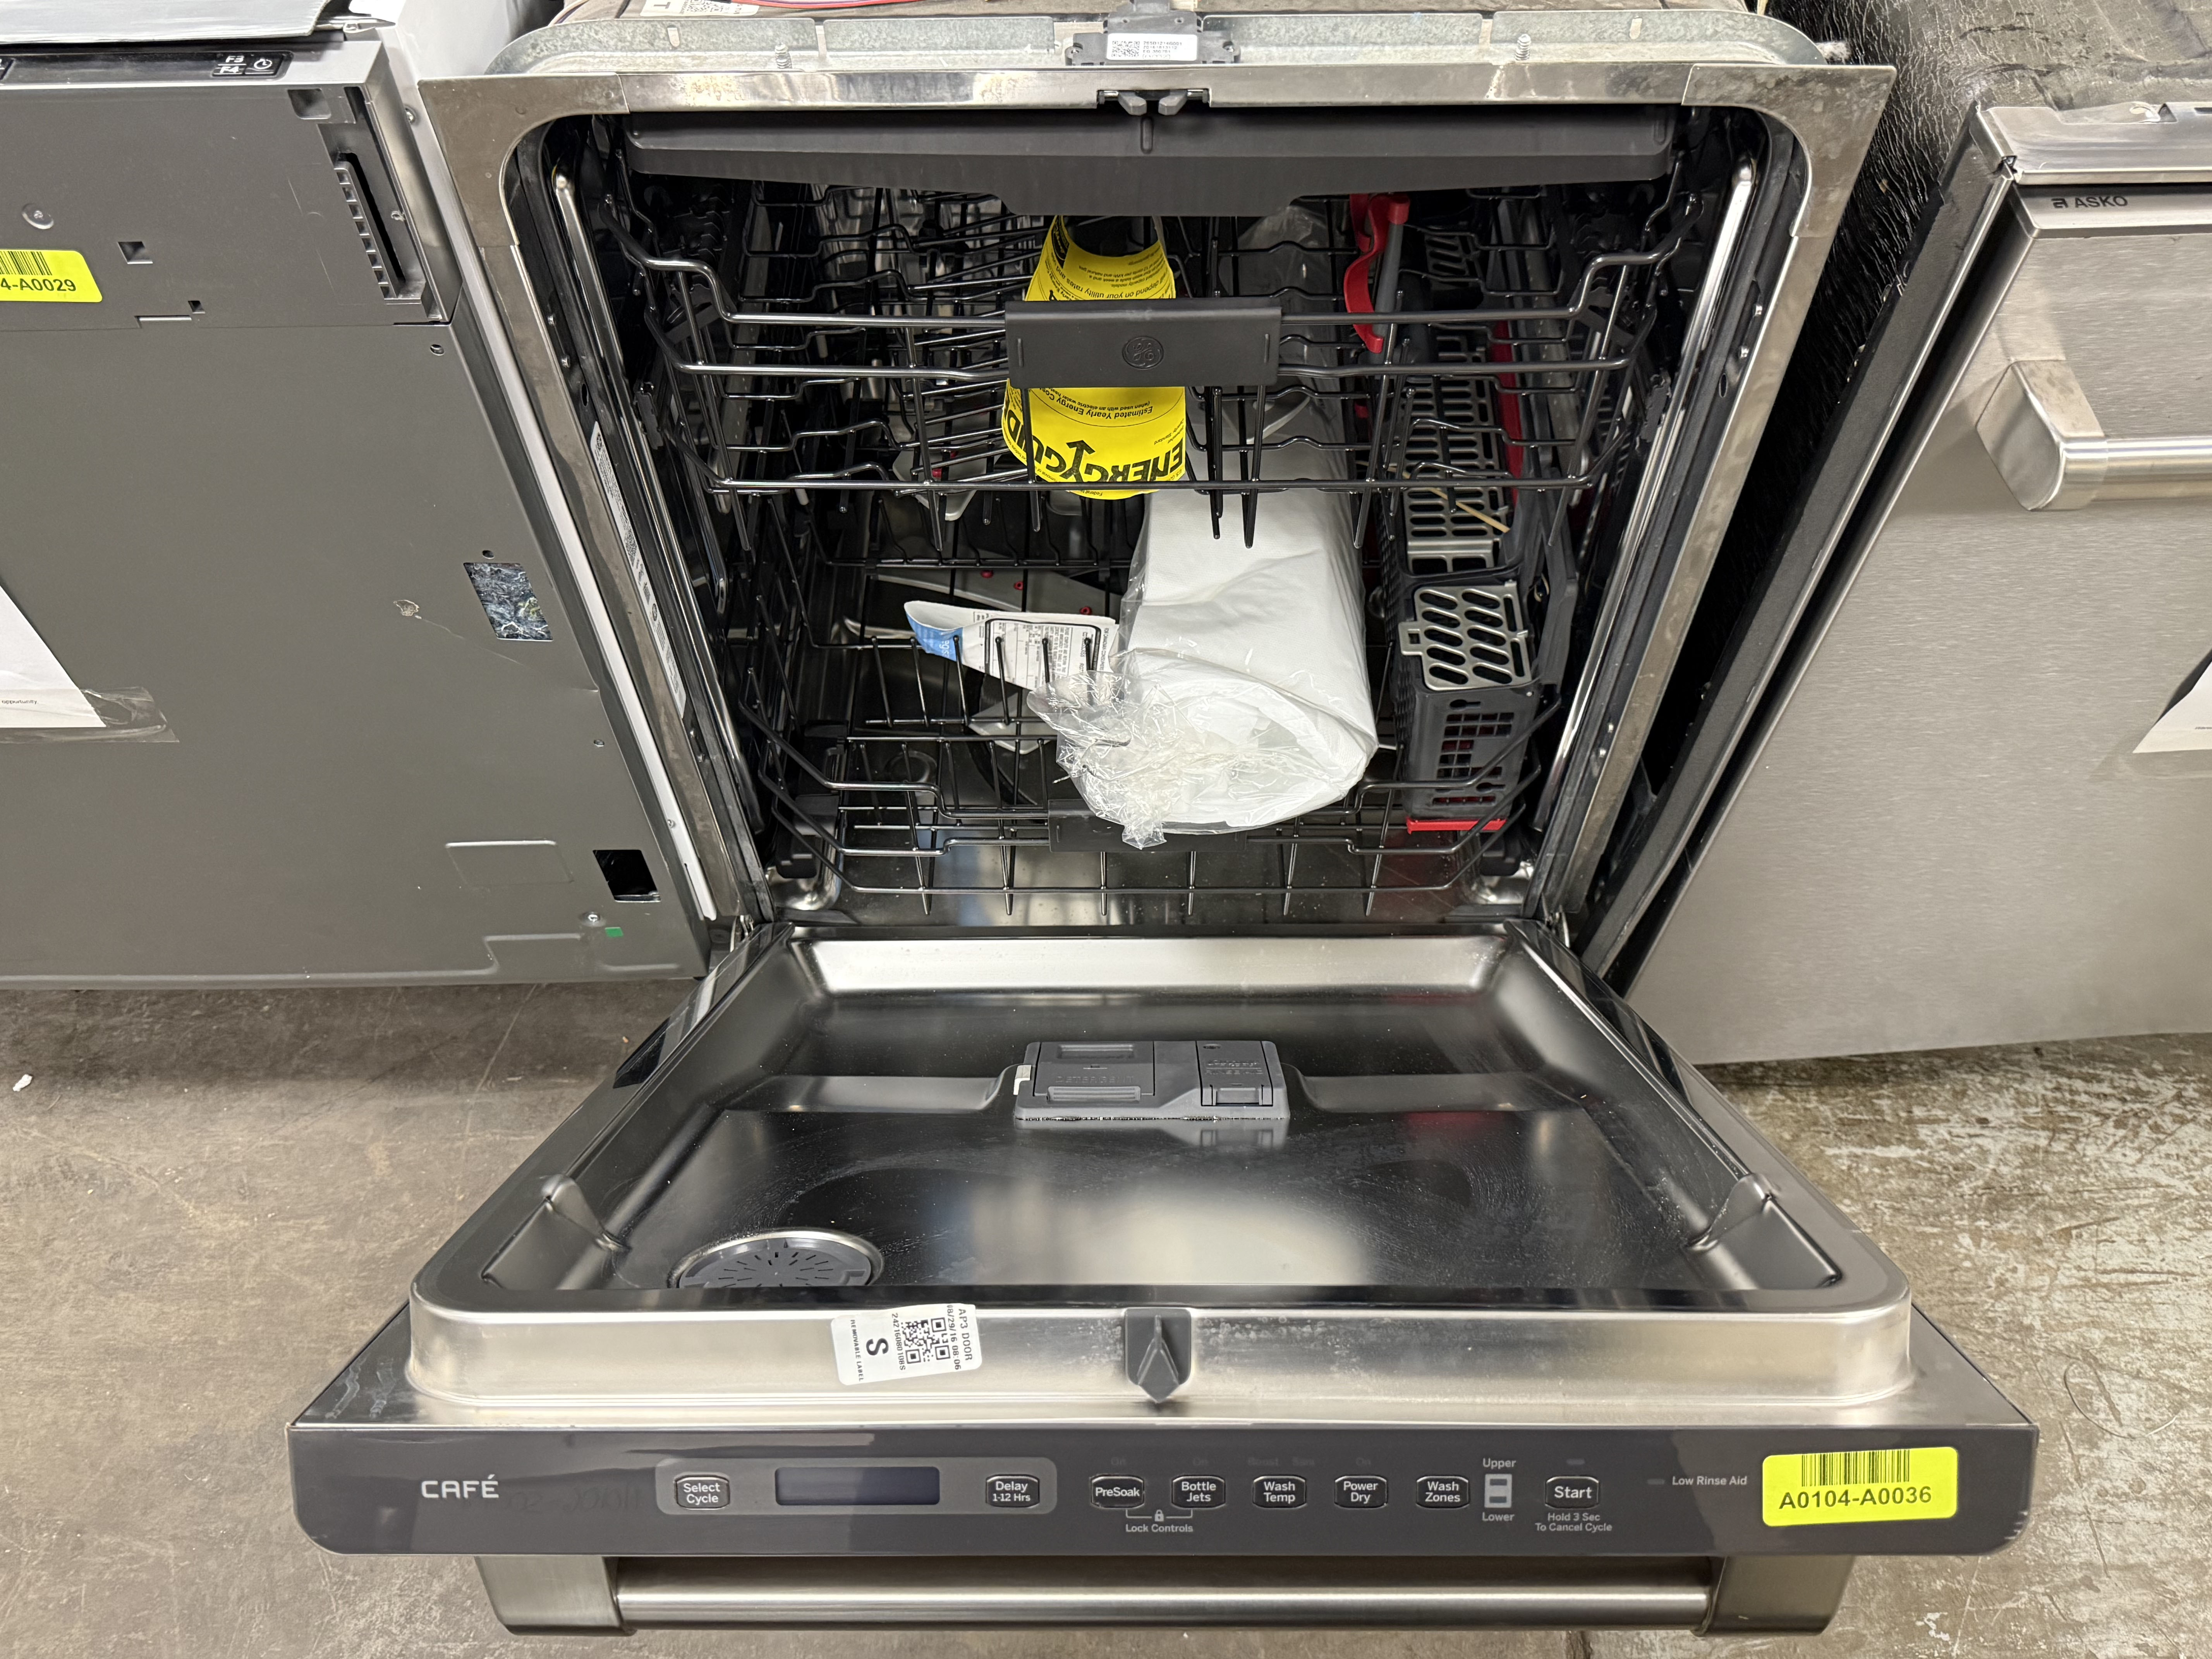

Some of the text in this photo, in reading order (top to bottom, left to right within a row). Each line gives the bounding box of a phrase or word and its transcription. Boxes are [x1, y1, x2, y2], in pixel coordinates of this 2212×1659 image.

[2075, 196, 2128, 208] ASKO
[1056, 266, 1066, 279] and
[1066, 278, 1083, 292] rates
[1136, 280, 1159, 297] depend
[1085, 289, 1104, 298] utility
[1062, 395, 1076, 404] water
[1056, 397, 1084, 415] Energy
[1077, 402, 1098, 410] electric
[1086, 409, 1112, 419] Yearly
[1114, 406, 1153, 419] Estimated
[850, 1319, 861, 1359] REMOVABLE
[946, 1305, 962, 1370] 08/29/16 08:06
[958, 1309, 973, 1361] AP3 DOOR
[866, 1338, 889, 1356] S
[1483, 1458, 1516, 1469] Upper
[1672, 1476, 1747, 1485] Low Rinse Aid
[422, 1474, 499, 1498] CAFÉ
[684, 1483, 720, 1492] Select
[996, 1481, 1028, 1492] Delay
[1182, 1481, 1216, 1491] Bottle
[1264, 1481, 1295, 1491] Wash
[1343, 1481, 1378, 1491] Power
[1427, 1481, 1459, 1491] Wash
[993, 1493, 1030, 1501] 1-12 Hrs
[1096, 1487, 1140, 1497] PreSoak
[1186, 1492, 1211, 1502] Jets
[1425, 1492, 1460, 1502] Zones
[1554, 1486, 1592, 1499] Start
[687, 1493, 718, 1504] Cycle
[1264, 1492, 1295, 1504] Temp
[1351, 1492, 1370, 1504] Dry
[1779, 1486, 1932, 1510] A0104-A0036
[1482, 1512, 1515, 1521] Lower
[1547, 1513, 1600, 1521] Hold 3 Sec
[1126, 1524, 1193, 1532] Lock Controls
[1535, 1523, 1613, 1533] To Cancel Cycle
